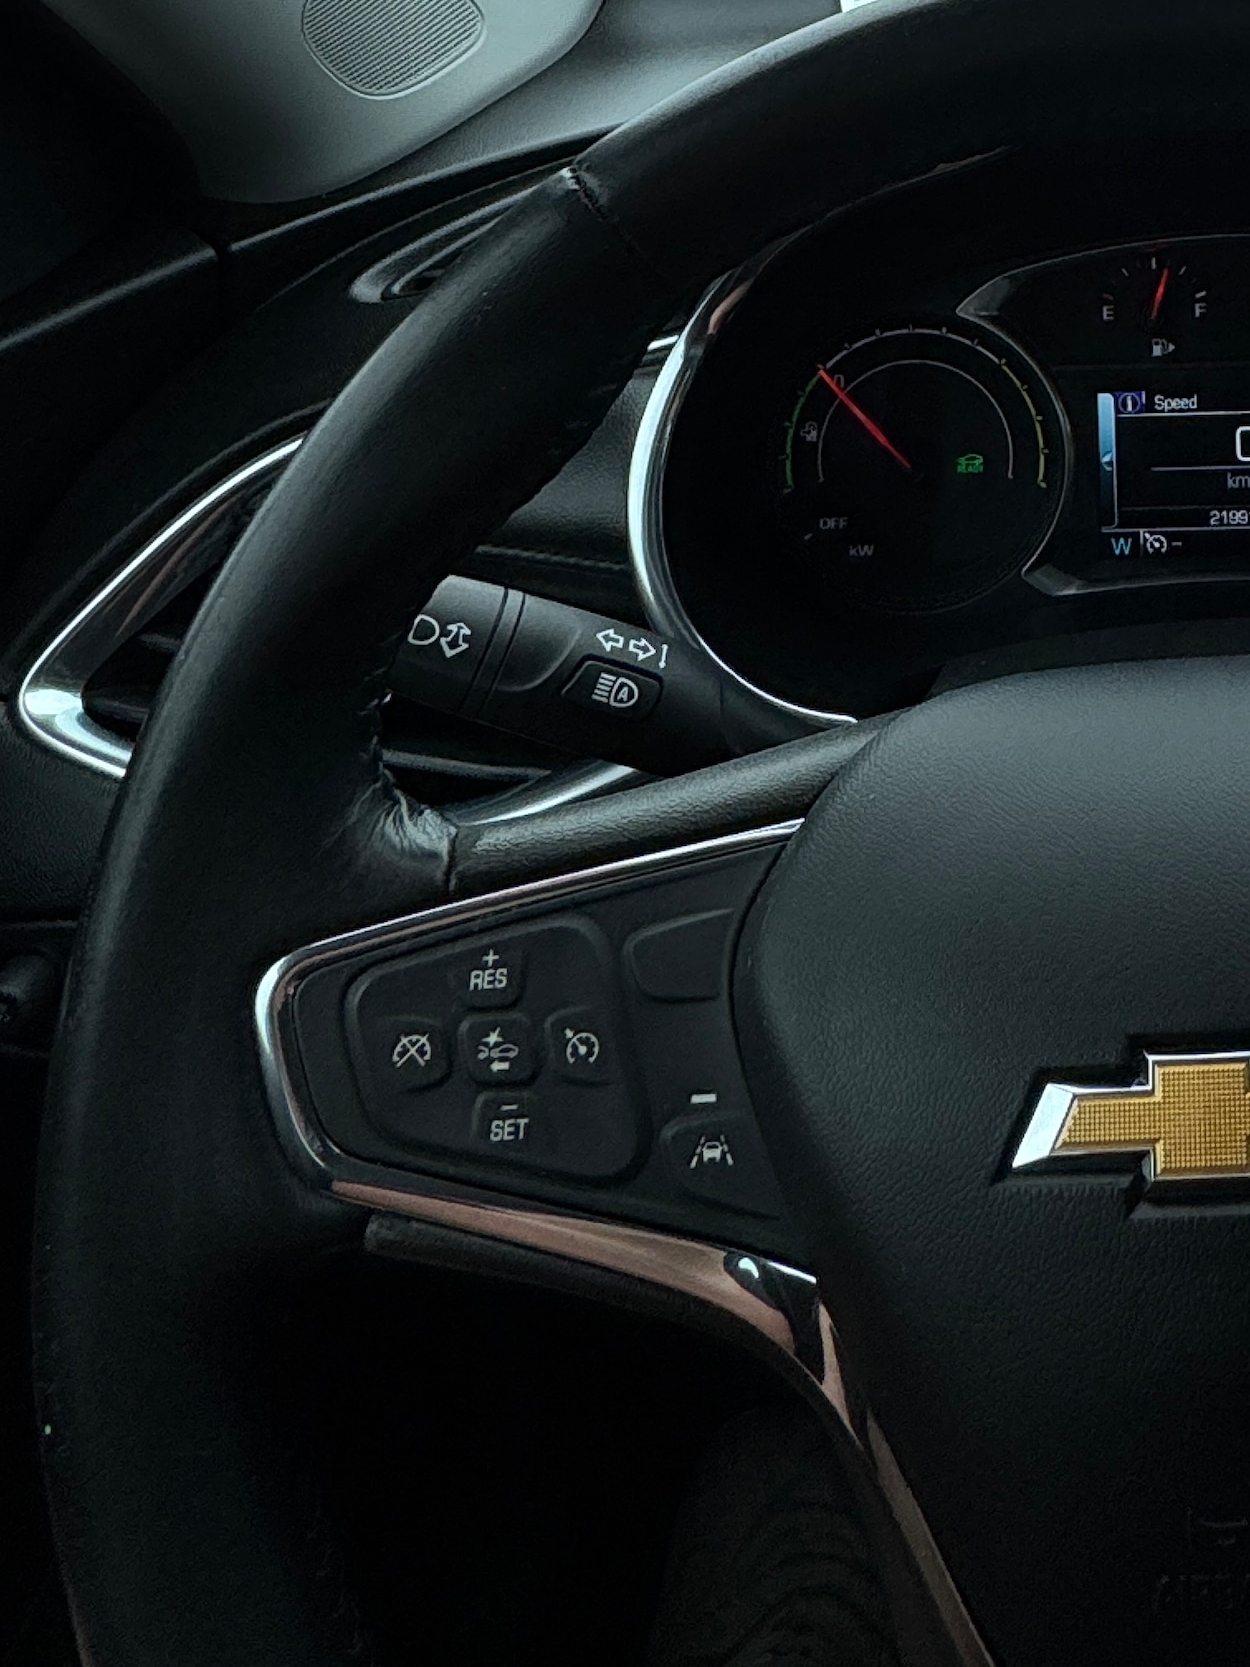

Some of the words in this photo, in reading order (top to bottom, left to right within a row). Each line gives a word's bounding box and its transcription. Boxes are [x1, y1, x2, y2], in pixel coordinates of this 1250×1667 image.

[1102, 306, 1115, 322] E
[1195, 303, 1207, 318] F
[1153, 394, 1198, 413] Speed
[819, 517, 849, 530] OFF
[849, 544, 875, 558] kW
[1111, 538, 1132, 555] W
[469, 968, 508, 992] RES
[489, 1117, 531, 1143] SET
